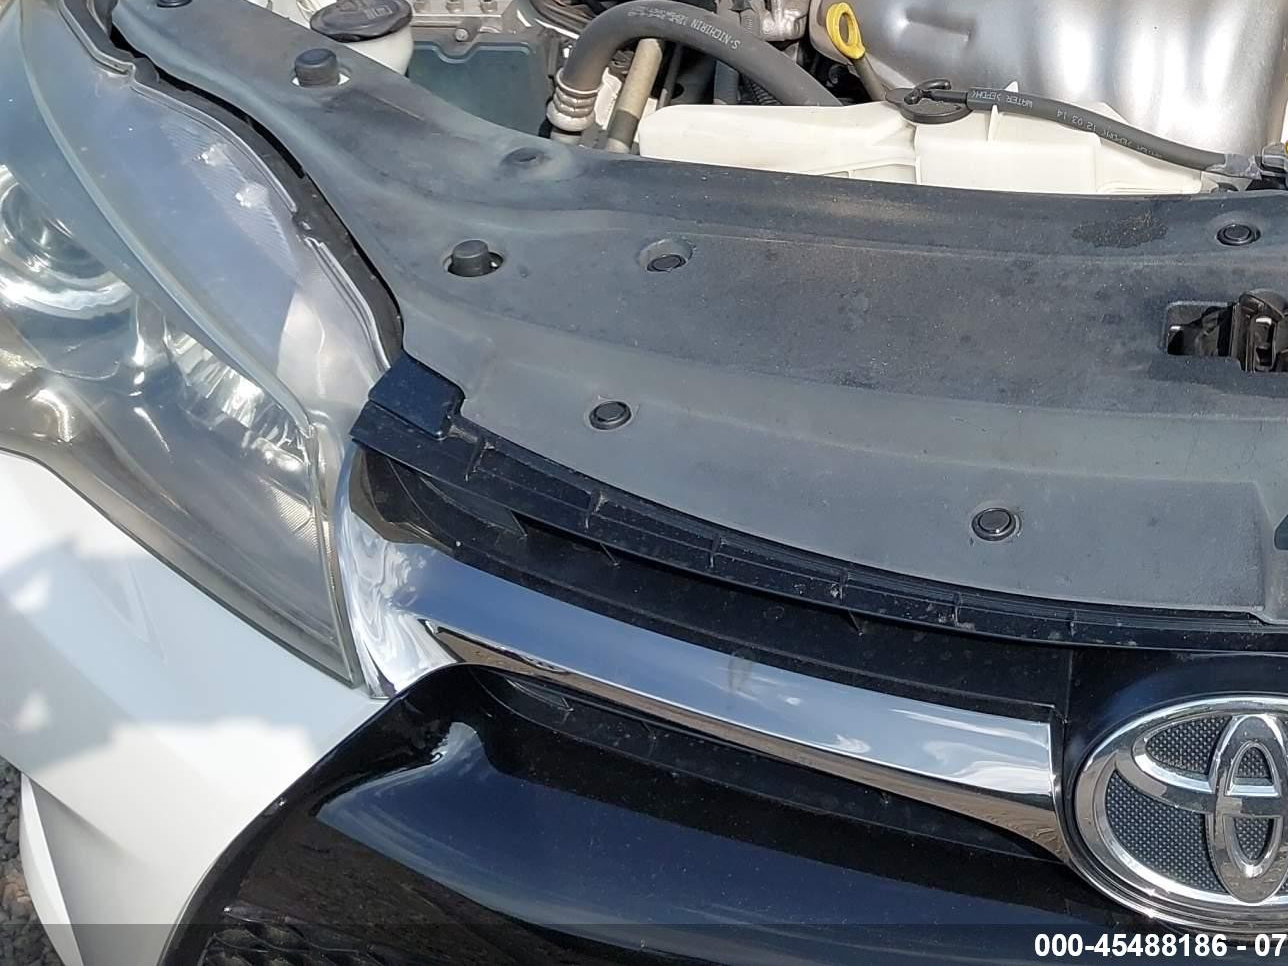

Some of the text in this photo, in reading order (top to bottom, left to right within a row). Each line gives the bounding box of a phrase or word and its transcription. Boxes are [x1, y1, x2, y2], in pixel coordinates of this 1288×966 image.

[1006, 96, 1033, 108] WATER
[1057, 108, 1068, 121] 14
[1071, 115, 1083, 126] 03
